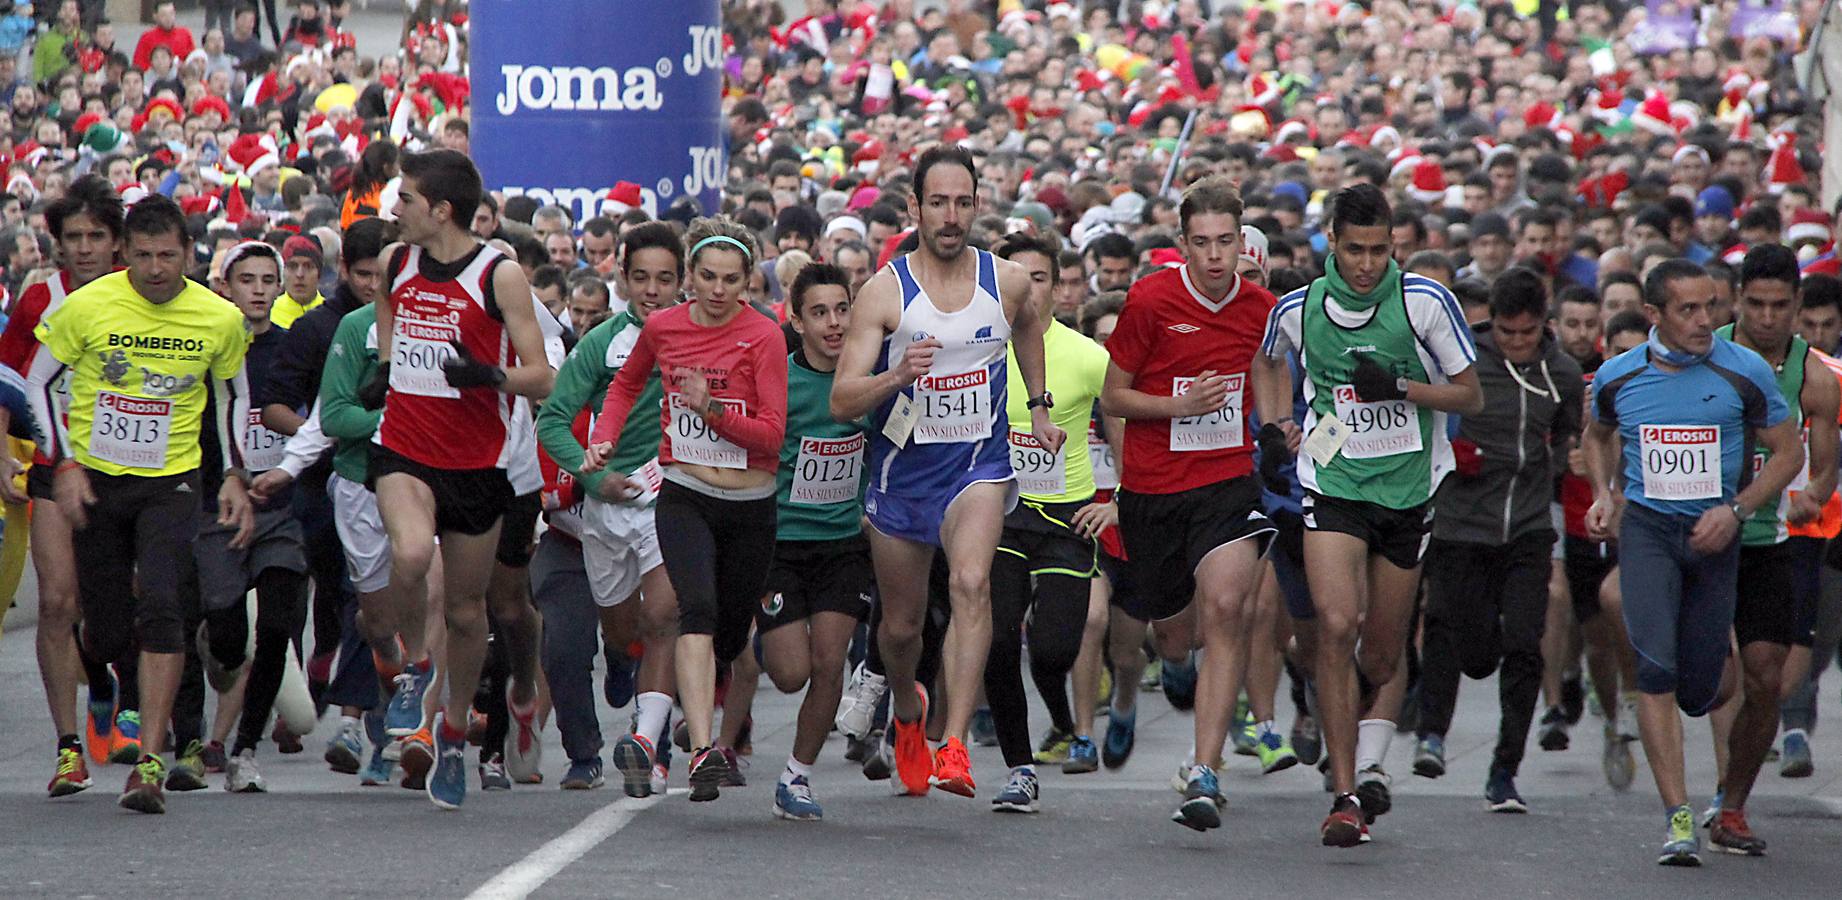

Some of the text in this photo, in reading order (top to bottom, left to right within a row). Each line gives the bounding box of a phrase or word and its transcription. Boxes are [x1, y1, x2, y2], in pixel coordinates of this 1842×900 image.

[410, 324, 454, 340] EROSKI
[108, 333, 204, 352] BOMBEROS
[396, 341, 451, 371] 5600
[939, 371, 984, 389] EROSKI
[117, 401, 167, 414] EROSKI
[923, 390, 980, 419] 1541
[1345, 402, 1408, 433] 4908
[99, 412, 159, 443] 3813
[919, 420, 985, 438] SAN SILVESTRE
[1663, 430, 1714, 442] EROSKI
[1014, 435, 1041, 447] ERO
[1176, 429, 1239, 445] SAN SILVESTRE
[1346, 433, 1415, 454] SAN SILVESTRE
[111, 446, 160, 463] SILVESTRE
[676, 443, 741, 463] SAN SILVESTRE
[823, 440, 861, 454] EROSKI
[803, 456, 855, 482] 0121
[1649, 449, 1709, 475] 0901
[797, 483, 855, 499] SAN SILVESTRE
[1650, 479, 1716, 494] SAN SILVESTRE
